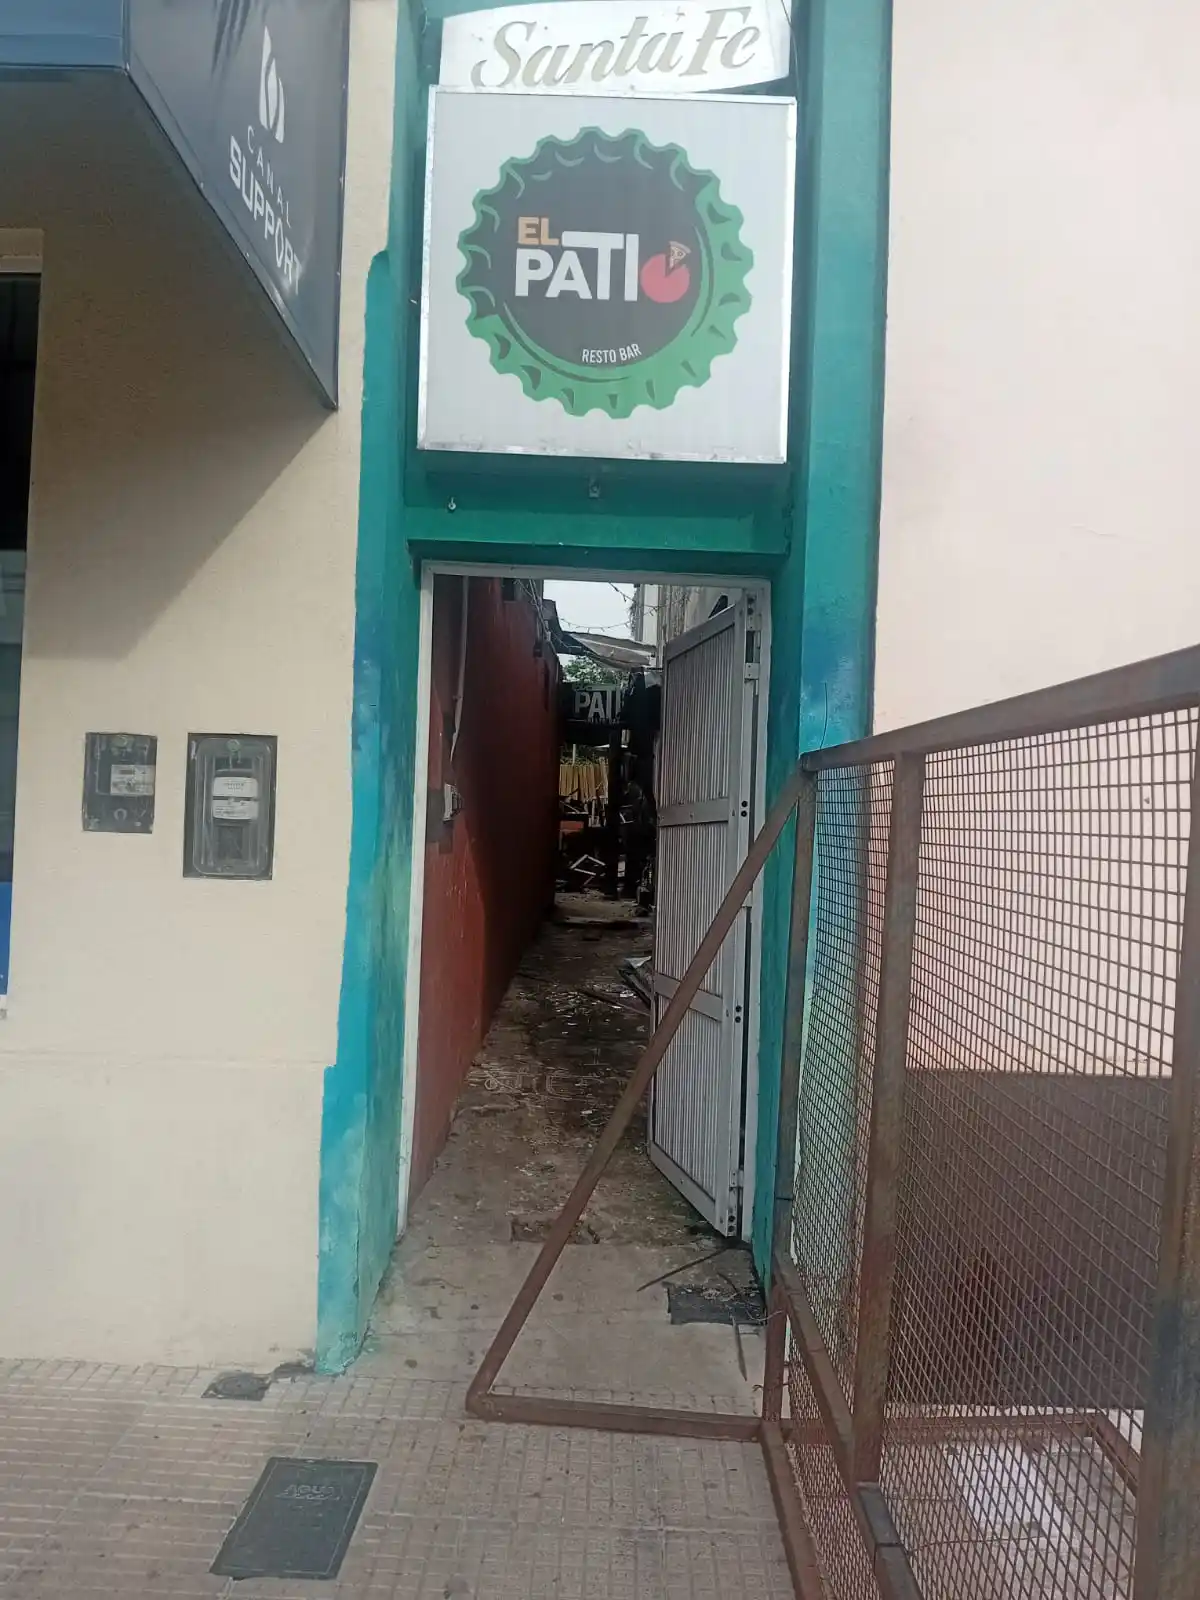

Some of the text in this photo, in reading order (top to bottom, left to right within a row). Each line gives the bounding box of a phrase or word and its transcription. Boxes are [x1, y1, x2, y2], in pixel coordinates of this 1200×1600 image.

[471, 6, 760, 88] Santa Fe
[228, 135, 302, 296] SUPPORT
[246, 124, 291, 229] CANAL
[517, 216, 559, 246] EL
[581, 343, 642, 364] RESTO BAR
